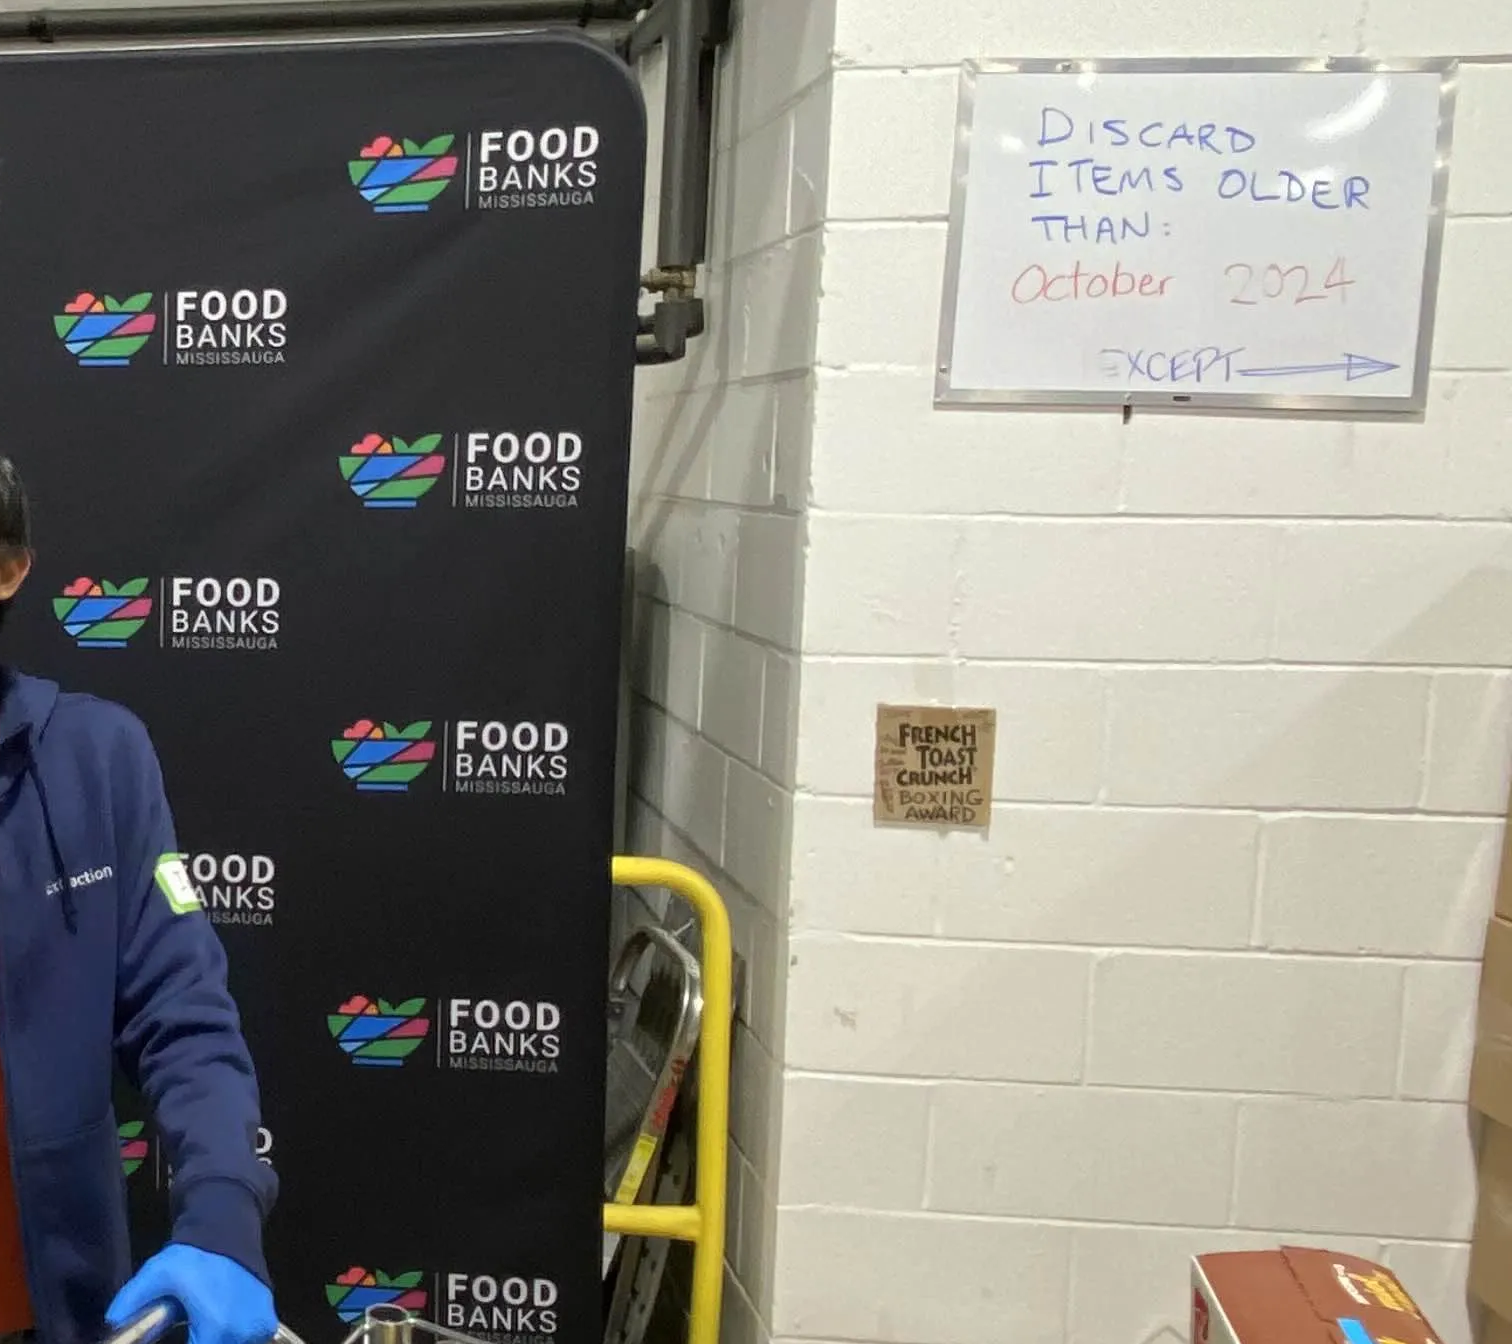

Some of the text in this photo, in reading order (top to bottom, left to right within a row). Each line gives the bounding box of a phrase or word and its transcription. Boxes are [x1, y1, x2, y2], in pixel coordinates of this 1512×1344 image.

[478, 125, 600, 164] FOOD
[1037, 107, 1256, 155] DISCARD
[478, 161, 598, 194] BANKS
[1029, 159, 1370, 209] ITEMS OLDER
[478, 191, 594, 210] MISSISSAUGA
[1031, 212, 1171, 244] THAN:
[1011, 256, 1356, 306] October 2024
[175, 289, 287, 322] FOOD
[175, 322, 287, 350] BANKS
[176, 351, 285, 366] MISSISSAUGA
[465, 432, 583, 464] FOOD
[465, 465, 581, 492] BANKS
[465, 494, 579, 509] MISSISSAUGA
[171, 577, 281, 608] FOOD
[171, 609, 280, 635] BANKS
[172, 635, 279, 651] MISSISSAUGA
[455, 720, 570, 753] FOOD
[898, 722, 977, 748] FRENCH
[454, 753, 569, 781] BANKS
[915, 745, 978, 770] TOAST
[455, 781, 567, 796] MISSISSAUGA
[896, 766, 974, 787] CRUNCH
[899, 788, 984, 806] BOXING
[904, 805, 977, 824] AWARD
[180, 853, 275, 885] OOD
[190, 884, 276, 911] ANKS
[449, 998, 561, 1032] FOOD
[448, 1029, 561, 1059] BANKS
[447, 1273, 558, 1307] FOOD
[447, 1303, 558, 1334] BANKS
